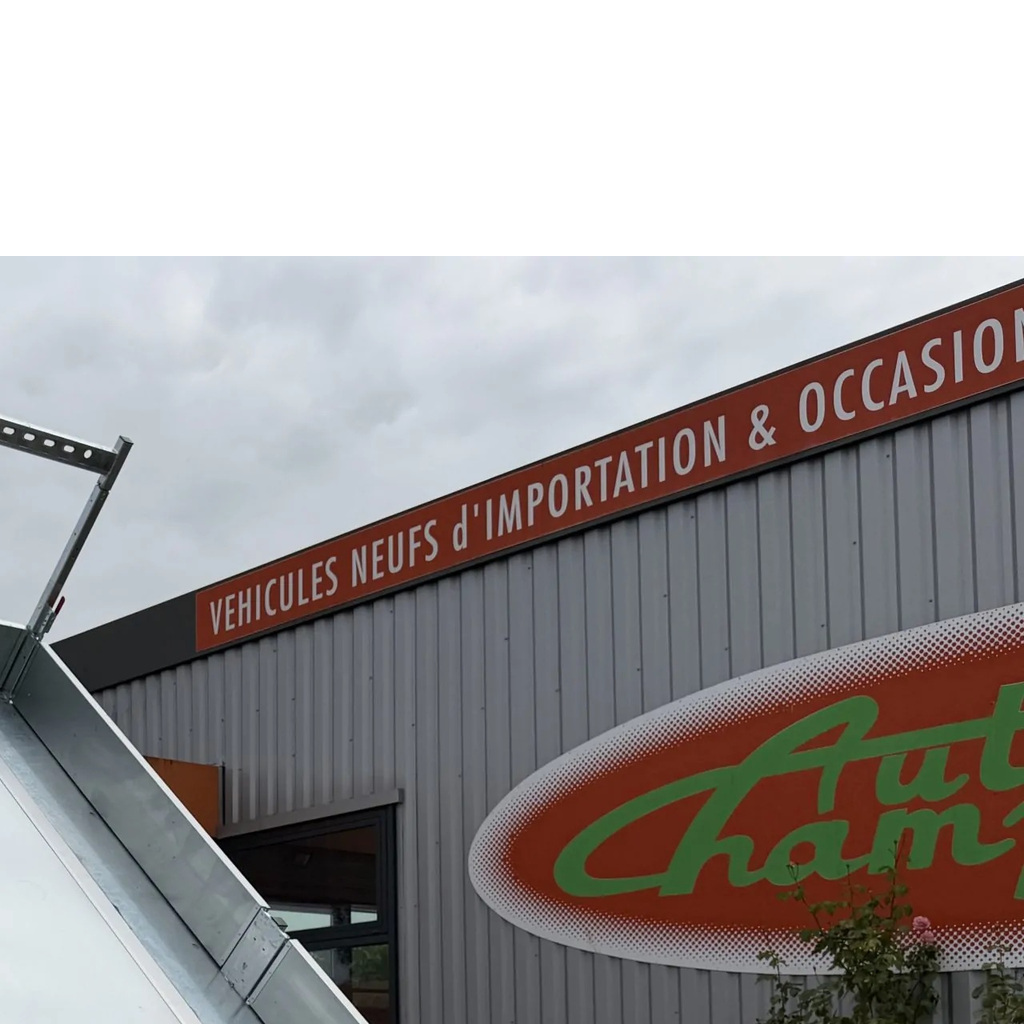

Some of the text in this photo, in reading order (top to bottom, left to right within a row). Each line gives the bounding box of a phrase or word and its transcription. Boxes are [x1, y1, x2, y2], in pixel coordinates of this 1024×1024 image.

[210, 556, 338, 635] VEHICULES
[351, 519, 439, 589] NEUFS
[452, 415, 726, 551] d'IMPORTATION
[748, 404, 776, 450] &
[553, 766, 1024, 899] Cham
